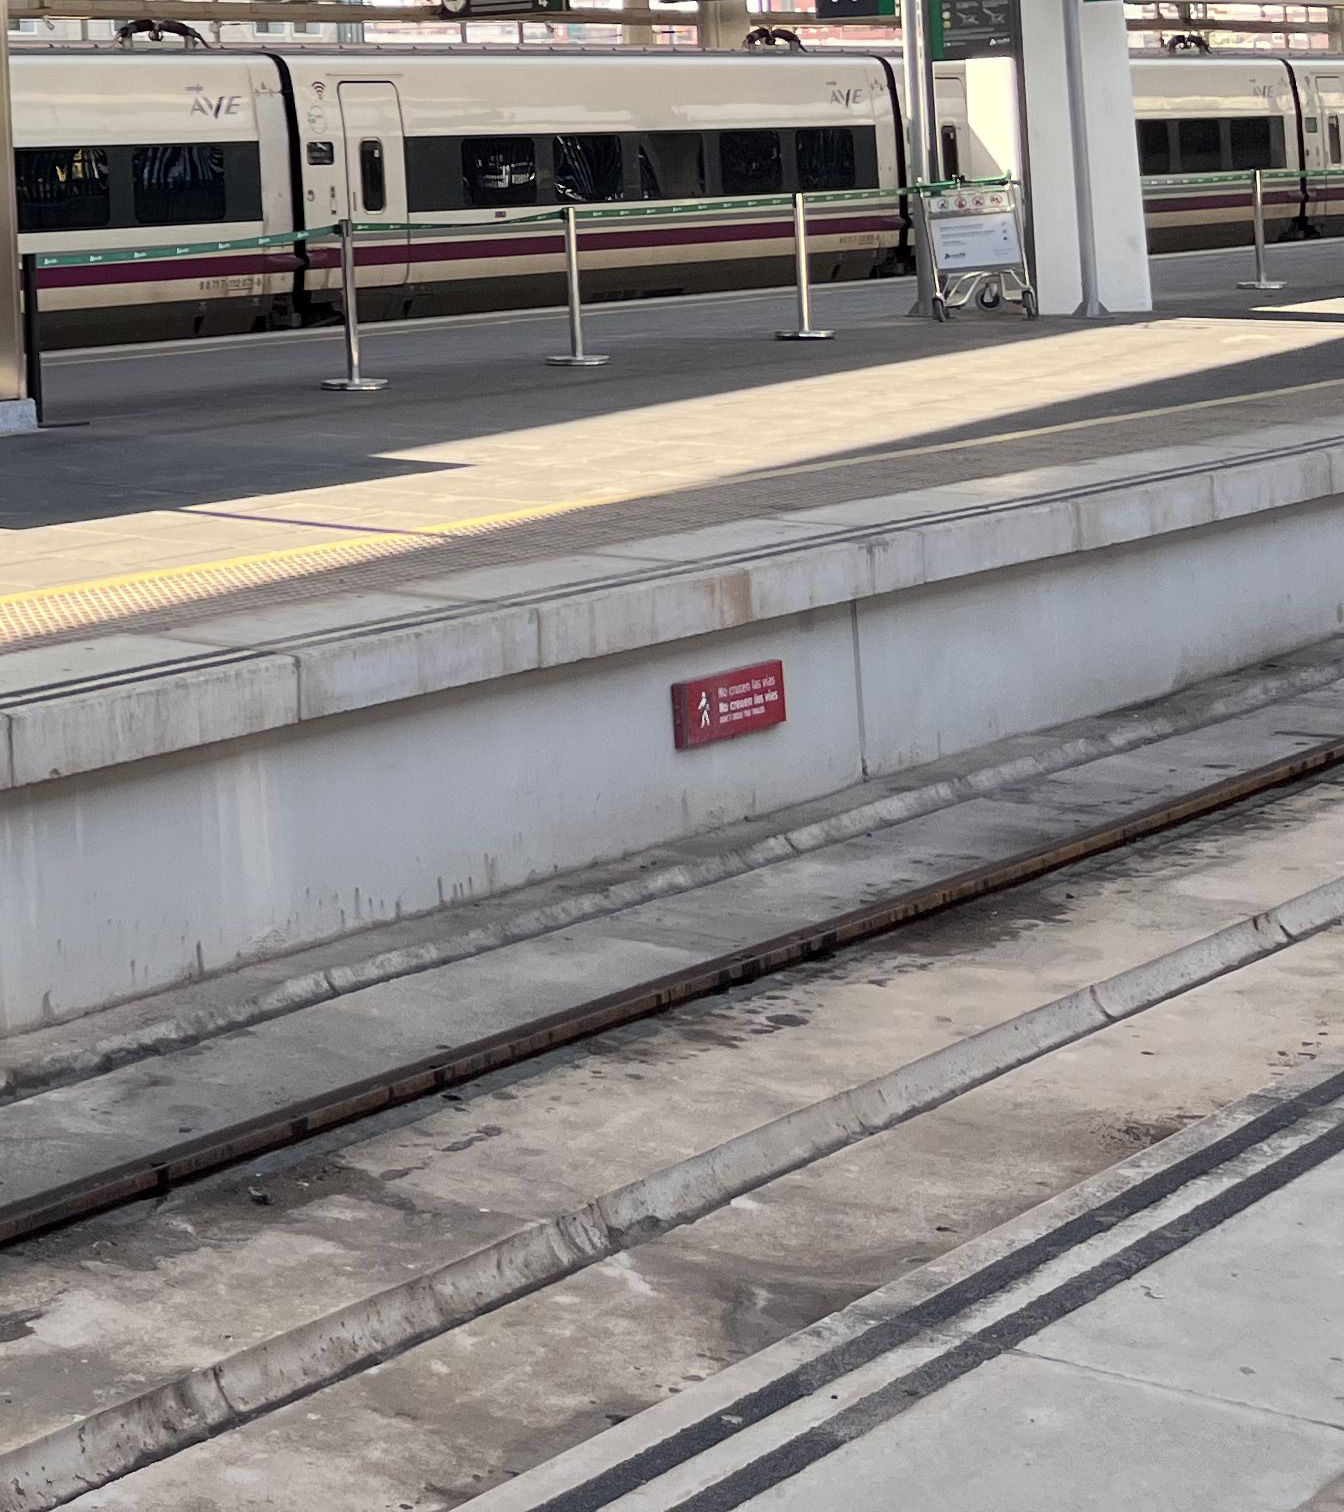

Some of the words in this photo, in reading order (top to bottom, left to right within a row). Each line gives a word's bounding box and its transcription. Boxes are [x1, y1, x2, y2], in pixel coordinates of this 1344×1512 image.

[830, 88, 863, 108] AVE
[190, 96, 242, 119] AVE
[718, 687, 728, 698] No
[719, 701, 729, 713] No
